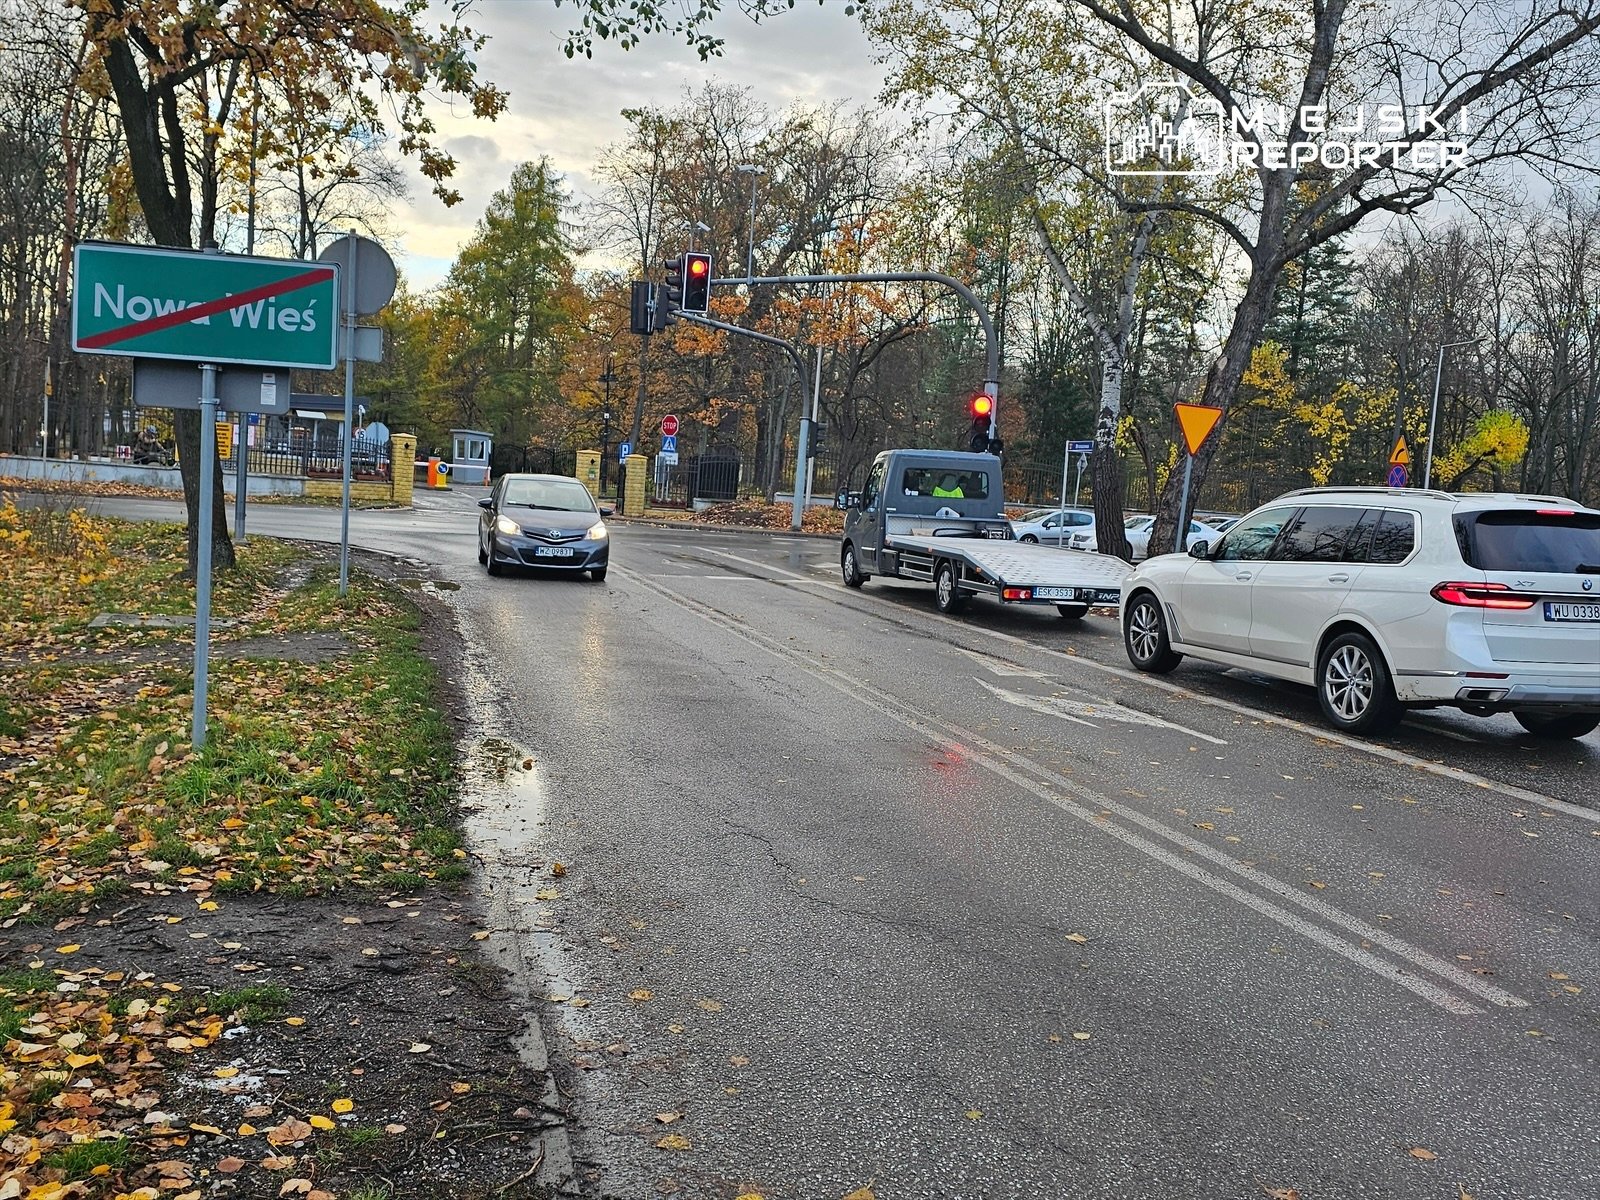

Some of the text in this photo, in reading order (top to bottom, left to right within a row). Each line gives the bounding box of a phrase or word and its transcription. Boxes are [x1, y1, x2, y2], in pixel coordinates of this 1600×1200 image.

[225, 292, 317, 332] Wieś
[663, 422, 677, 430] STOP
[1038, 587, 1052, 597] ESK
[1553, 604, 1569, 618] WU
[1572, 605, 1600, 619] 0338
